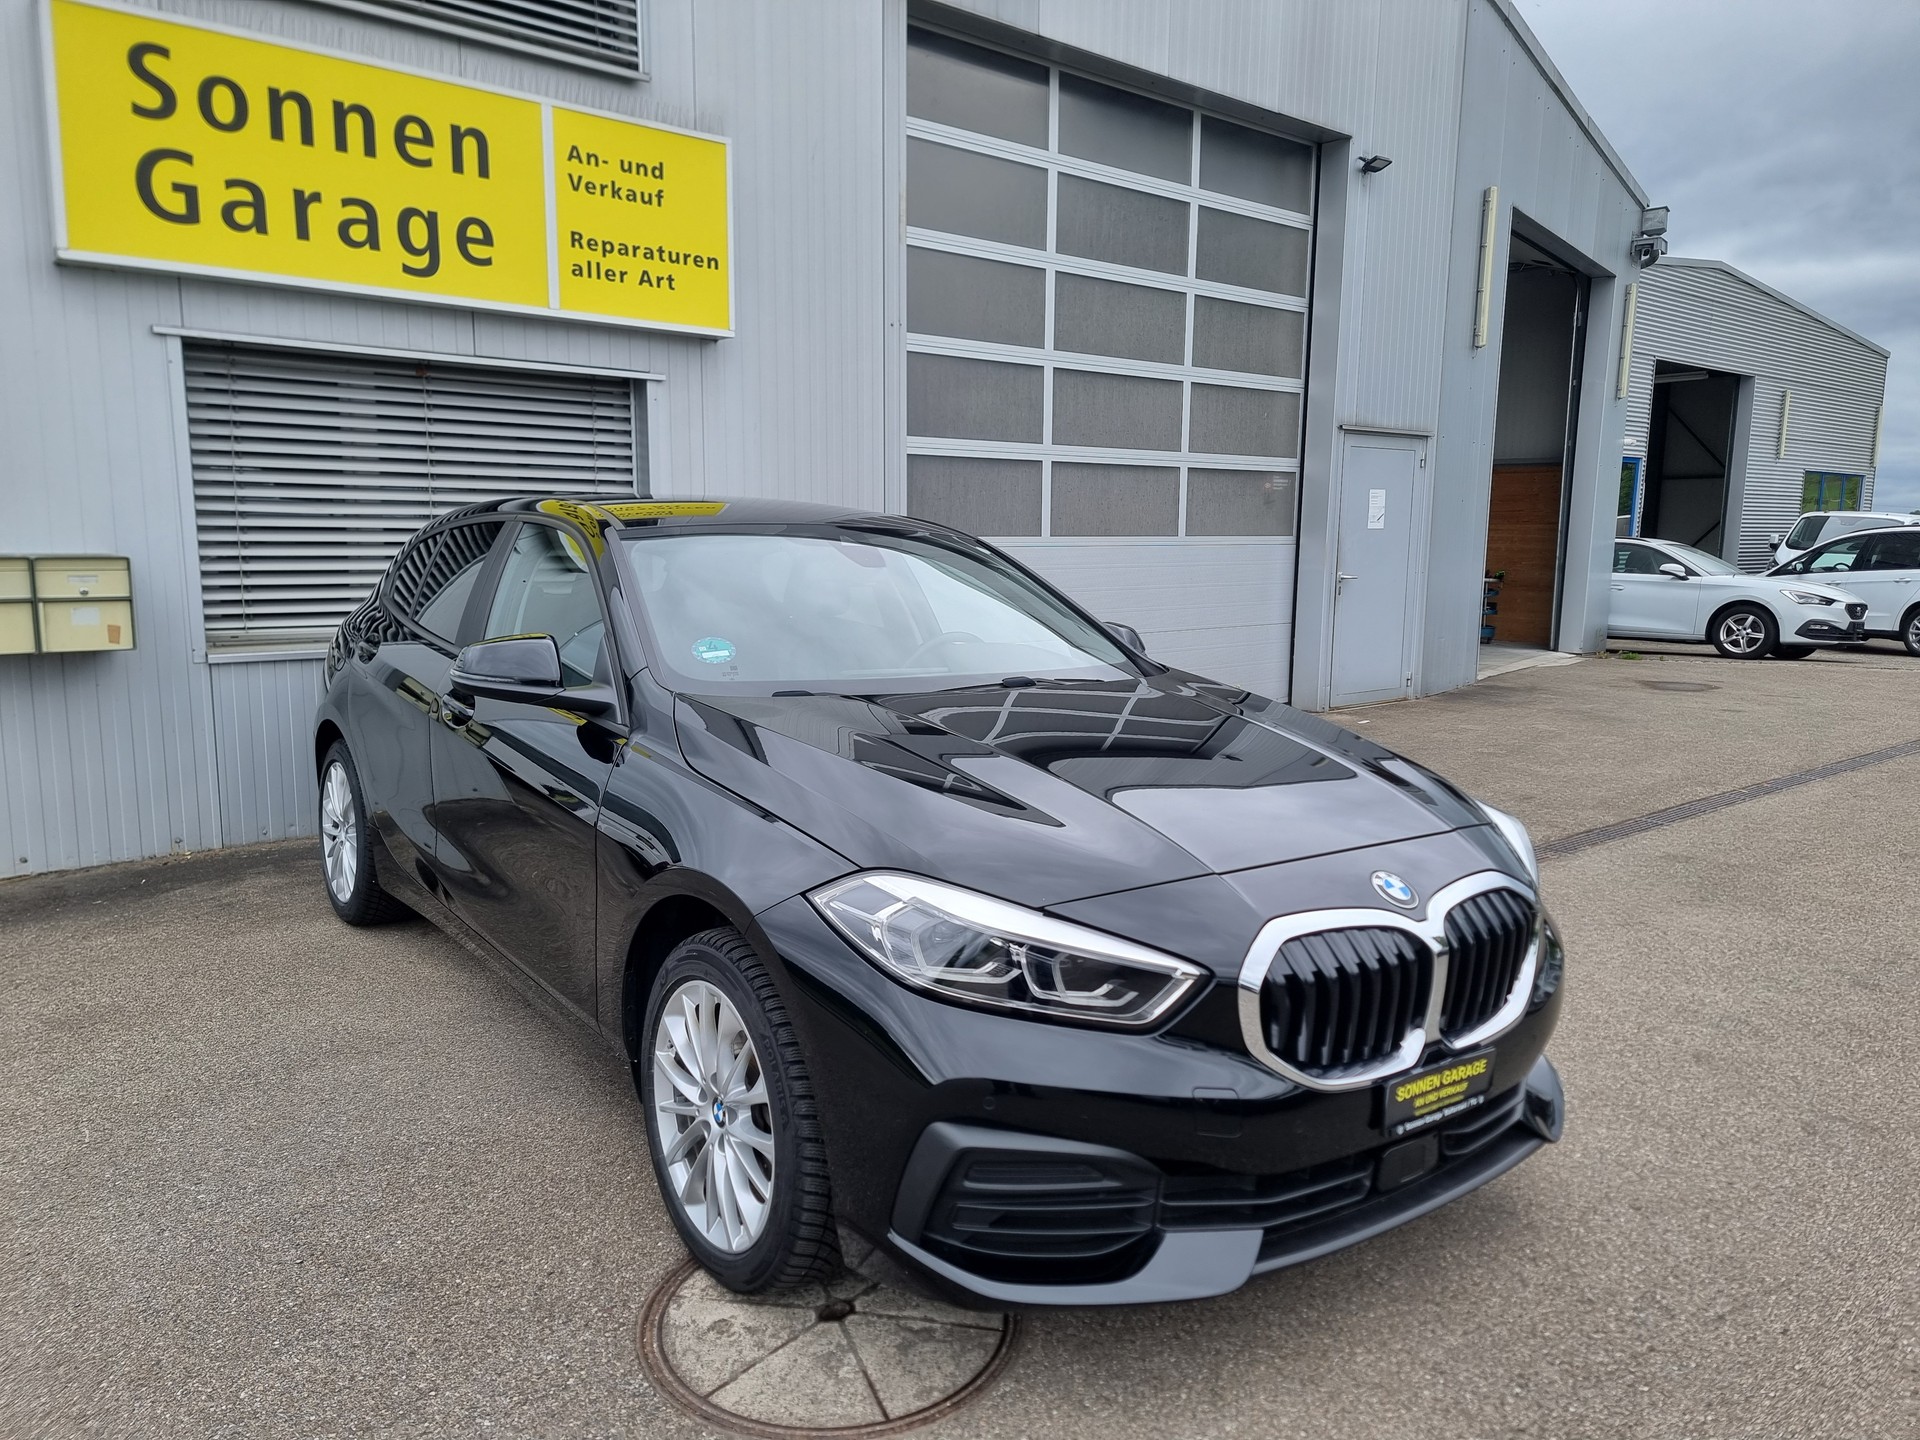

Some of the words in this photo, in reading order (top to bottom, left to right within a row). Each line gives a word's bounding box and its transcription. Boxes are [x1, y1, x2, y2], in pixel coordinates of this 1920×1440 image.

[126, 41, 491, 180] Sonnen
[567, 144, 609, 168] An-
[619, 159, 664, 181] und
[567, 172, 665, 208] Verkauf
[134, 147, 495, 278] Garage
[570, 230, 719, 271] Reparaturen
[571, 260, 628, 284] aller
[638, 269, 676, 291] Art
[1396, 1074, 1441, 1102] SONNEN
[1442, 1060, 1487, 1084] GARAGE
